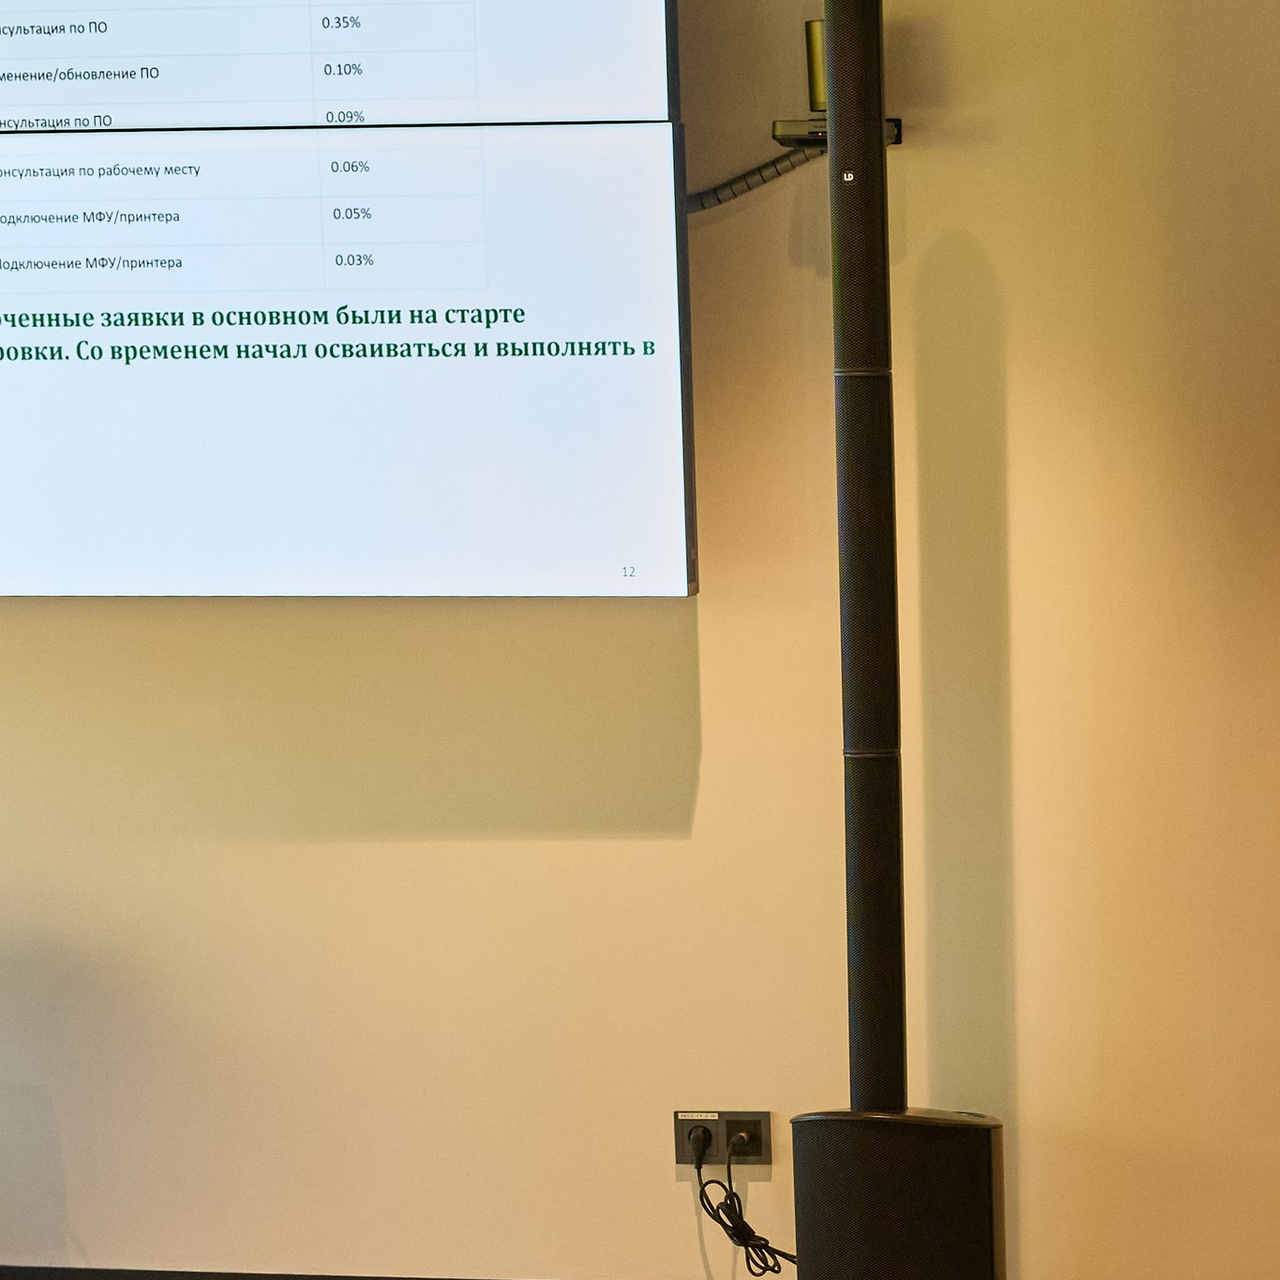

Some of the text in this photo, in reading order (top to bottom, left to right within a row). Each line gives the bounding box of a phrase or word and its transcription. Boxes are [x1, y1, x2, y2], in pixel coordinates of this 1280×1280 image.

[322, 16, 361, 28] 0.35%
[0, 21, 107, 37] сультация по ПО
[141, 67, 159, 79] ПО
[324, 64, 362, 75] 0.10%
[75, 118, 89, 127] по
[94, 115, 112, 127] ПО
[326, 110, 364, 122] 0.09%
[79, 168, 94, 176] по
[98, 164, 160, 178] рабочему
[164, 166, 200, 177] месту
[331, 161, 369, 172] 0.06%
[843, 172, 855, 182] LD
[83, 210, 179, 224] МФУ/принтера
[333, 208, 372, 219] 0.05%
[0, 256, 182, 271] одключение МФУ/принтера
[335, 254, 374, 266] 0.03%
[0, 304, 525, 329] ченные заявки в основном были на старте
[76, 340, 103, 360] Со
[110, 345, 229, 365] временем
[236, 344, 307, 359] начал
[315, 343, 466, 358] осваиваться
[474, 343, 488, 356] и
[496, 341, 635, 357] выполнять
[643, 341, 655, 355] в
[623, 567, 635, 577] 12
